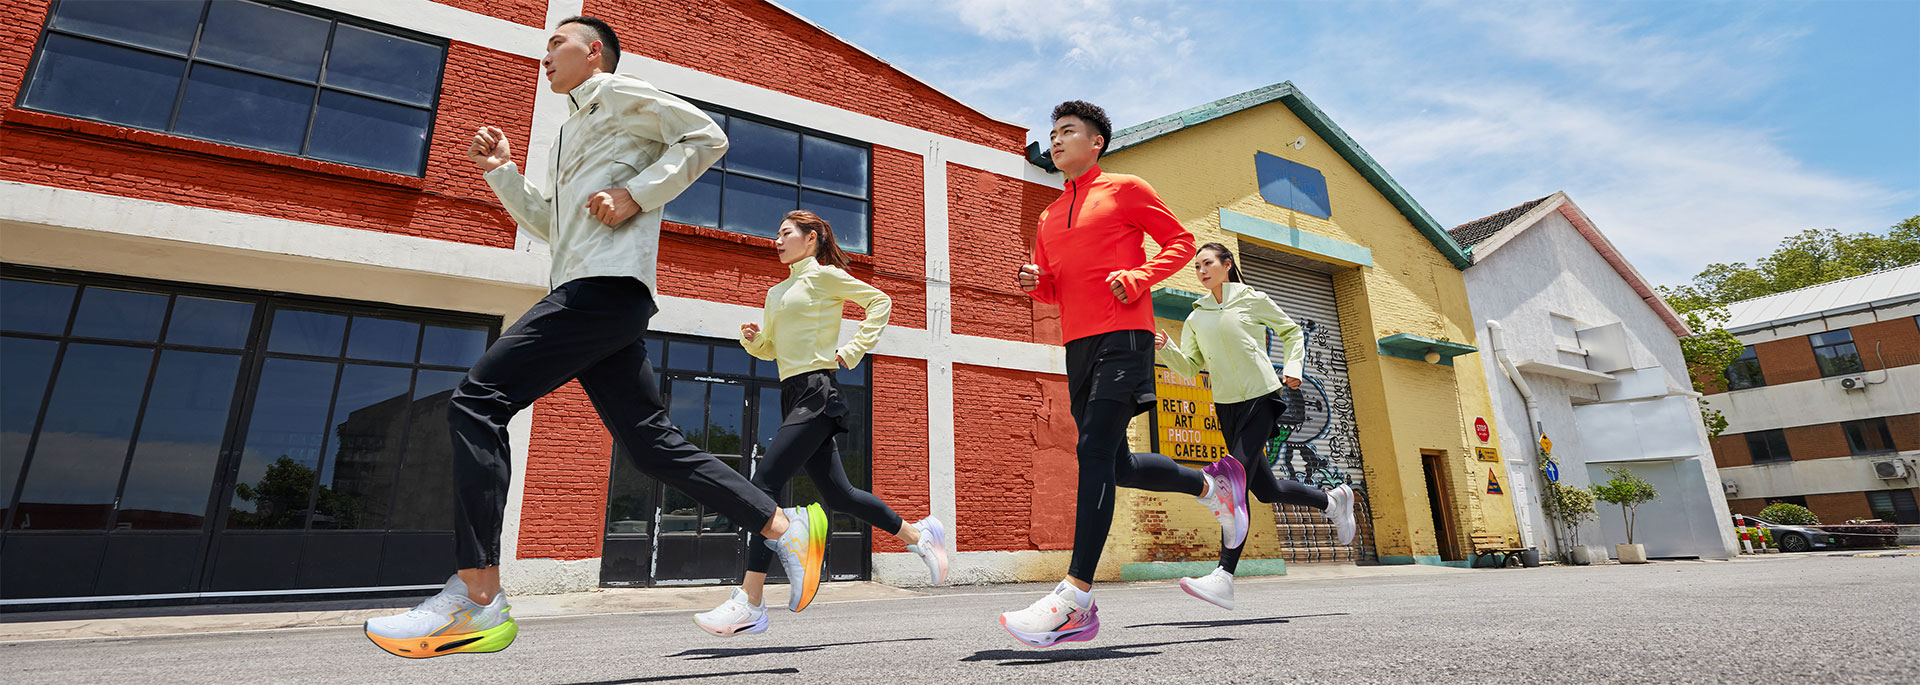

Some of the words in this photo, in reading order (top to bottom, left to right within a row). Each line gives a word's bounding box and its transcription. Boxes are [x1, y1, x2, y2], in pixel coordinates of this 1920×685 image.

[1202, 375, 1211, 389] W
[1163, 399, 1196, 414] RETRO
[1175, 414, 1193, 428] ART
[1168, 428, 1201, 443] PHOTO
